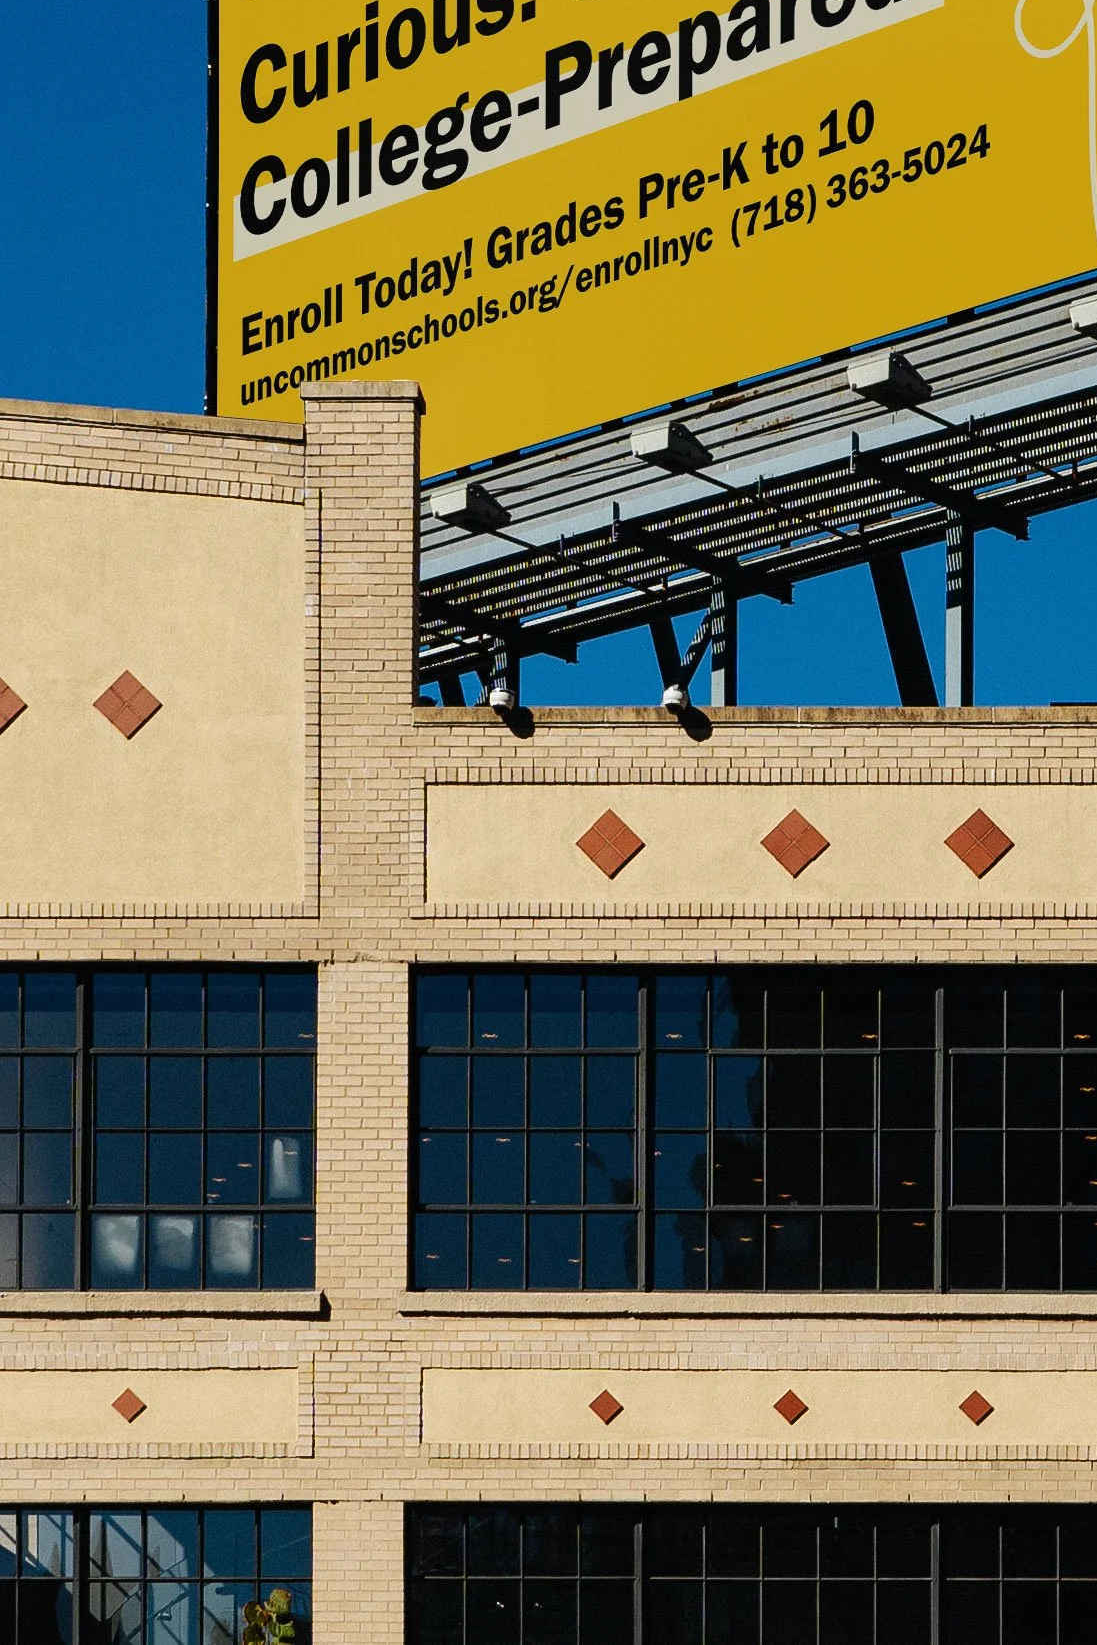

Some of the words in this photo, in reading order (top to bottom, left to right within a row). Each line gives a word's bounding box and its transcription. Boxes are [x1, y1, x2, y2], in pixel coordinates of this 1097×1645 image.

[240, 227, 714, 406] uncommonschools.org/enrollnyc
[731, 183, 817, 248] (718)
[826, 123, 992, 209] 363-5024
[241, 283, 343, 356] Enroll
[354, 237, 474, 315] Today!
[486, 196, 625, 269] Grades
[639, 141, 751, 220] Pre-K
[761, 132, 804, 175] to
[818, 99, 876, 158] 10
